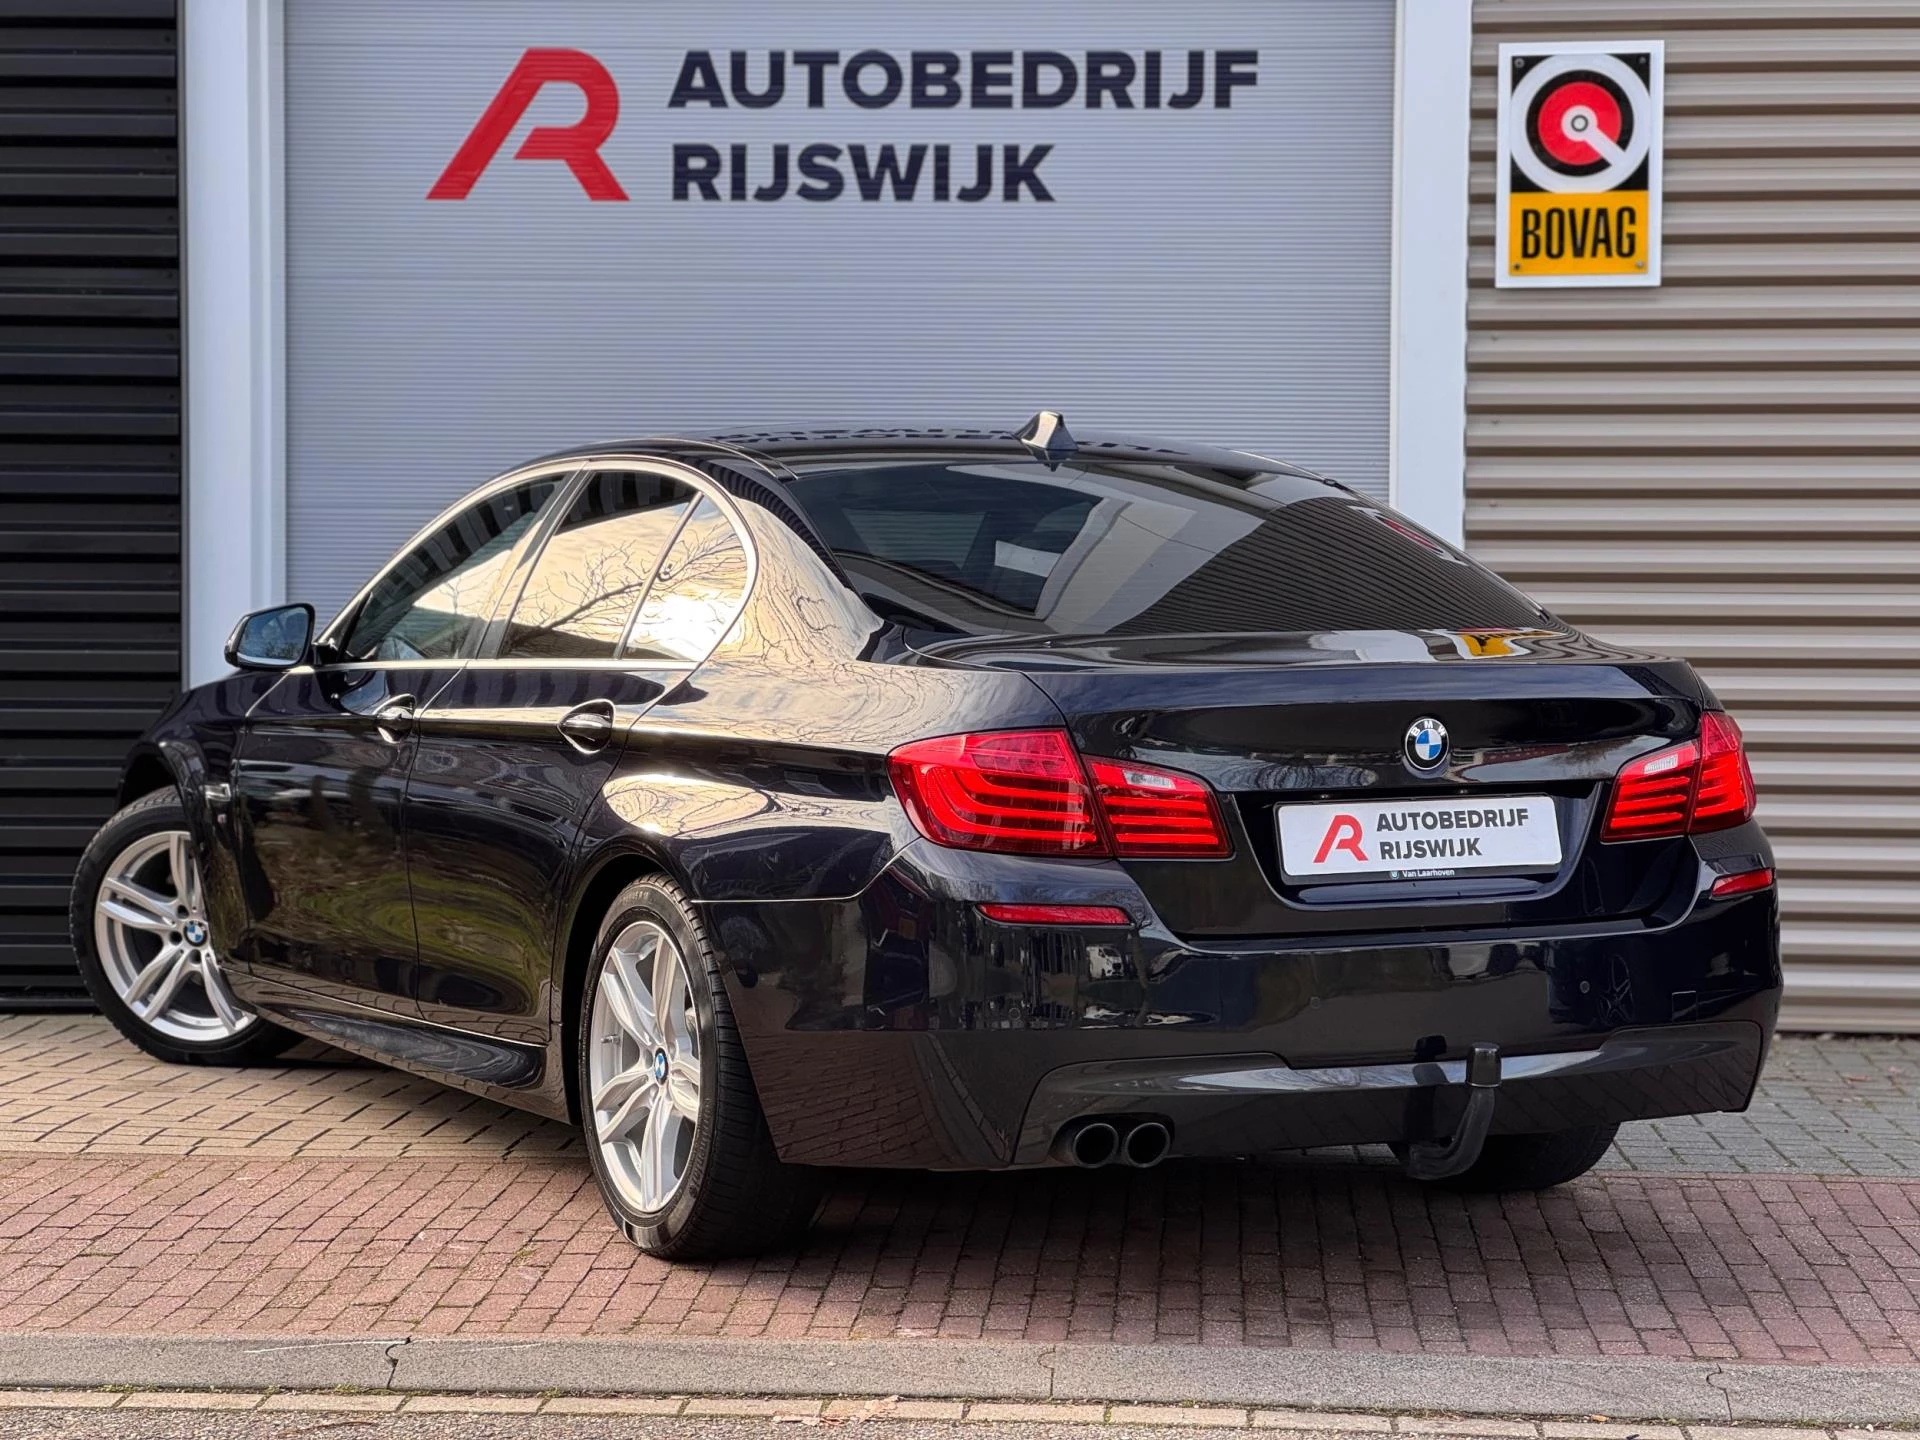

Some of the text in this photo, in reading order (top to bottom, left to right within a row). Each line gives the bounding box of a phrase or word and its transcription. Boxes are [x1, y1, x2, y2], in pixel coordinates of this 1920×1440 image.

[668, 50, 1259, 109] AUTOBEDRIJF
[672, 143, 1055, 202] RIJSWIJK
[1521, 206, 1636, 259] BOVAG
[1410, 720, 1447, 737] BMW
[1376, 808, 1529, 832] AUTOBEDRIJF
[1379, 837, 1482, 860] RIJSWIJK
[1402, 868, 1455, 878] Van Laarhoven
